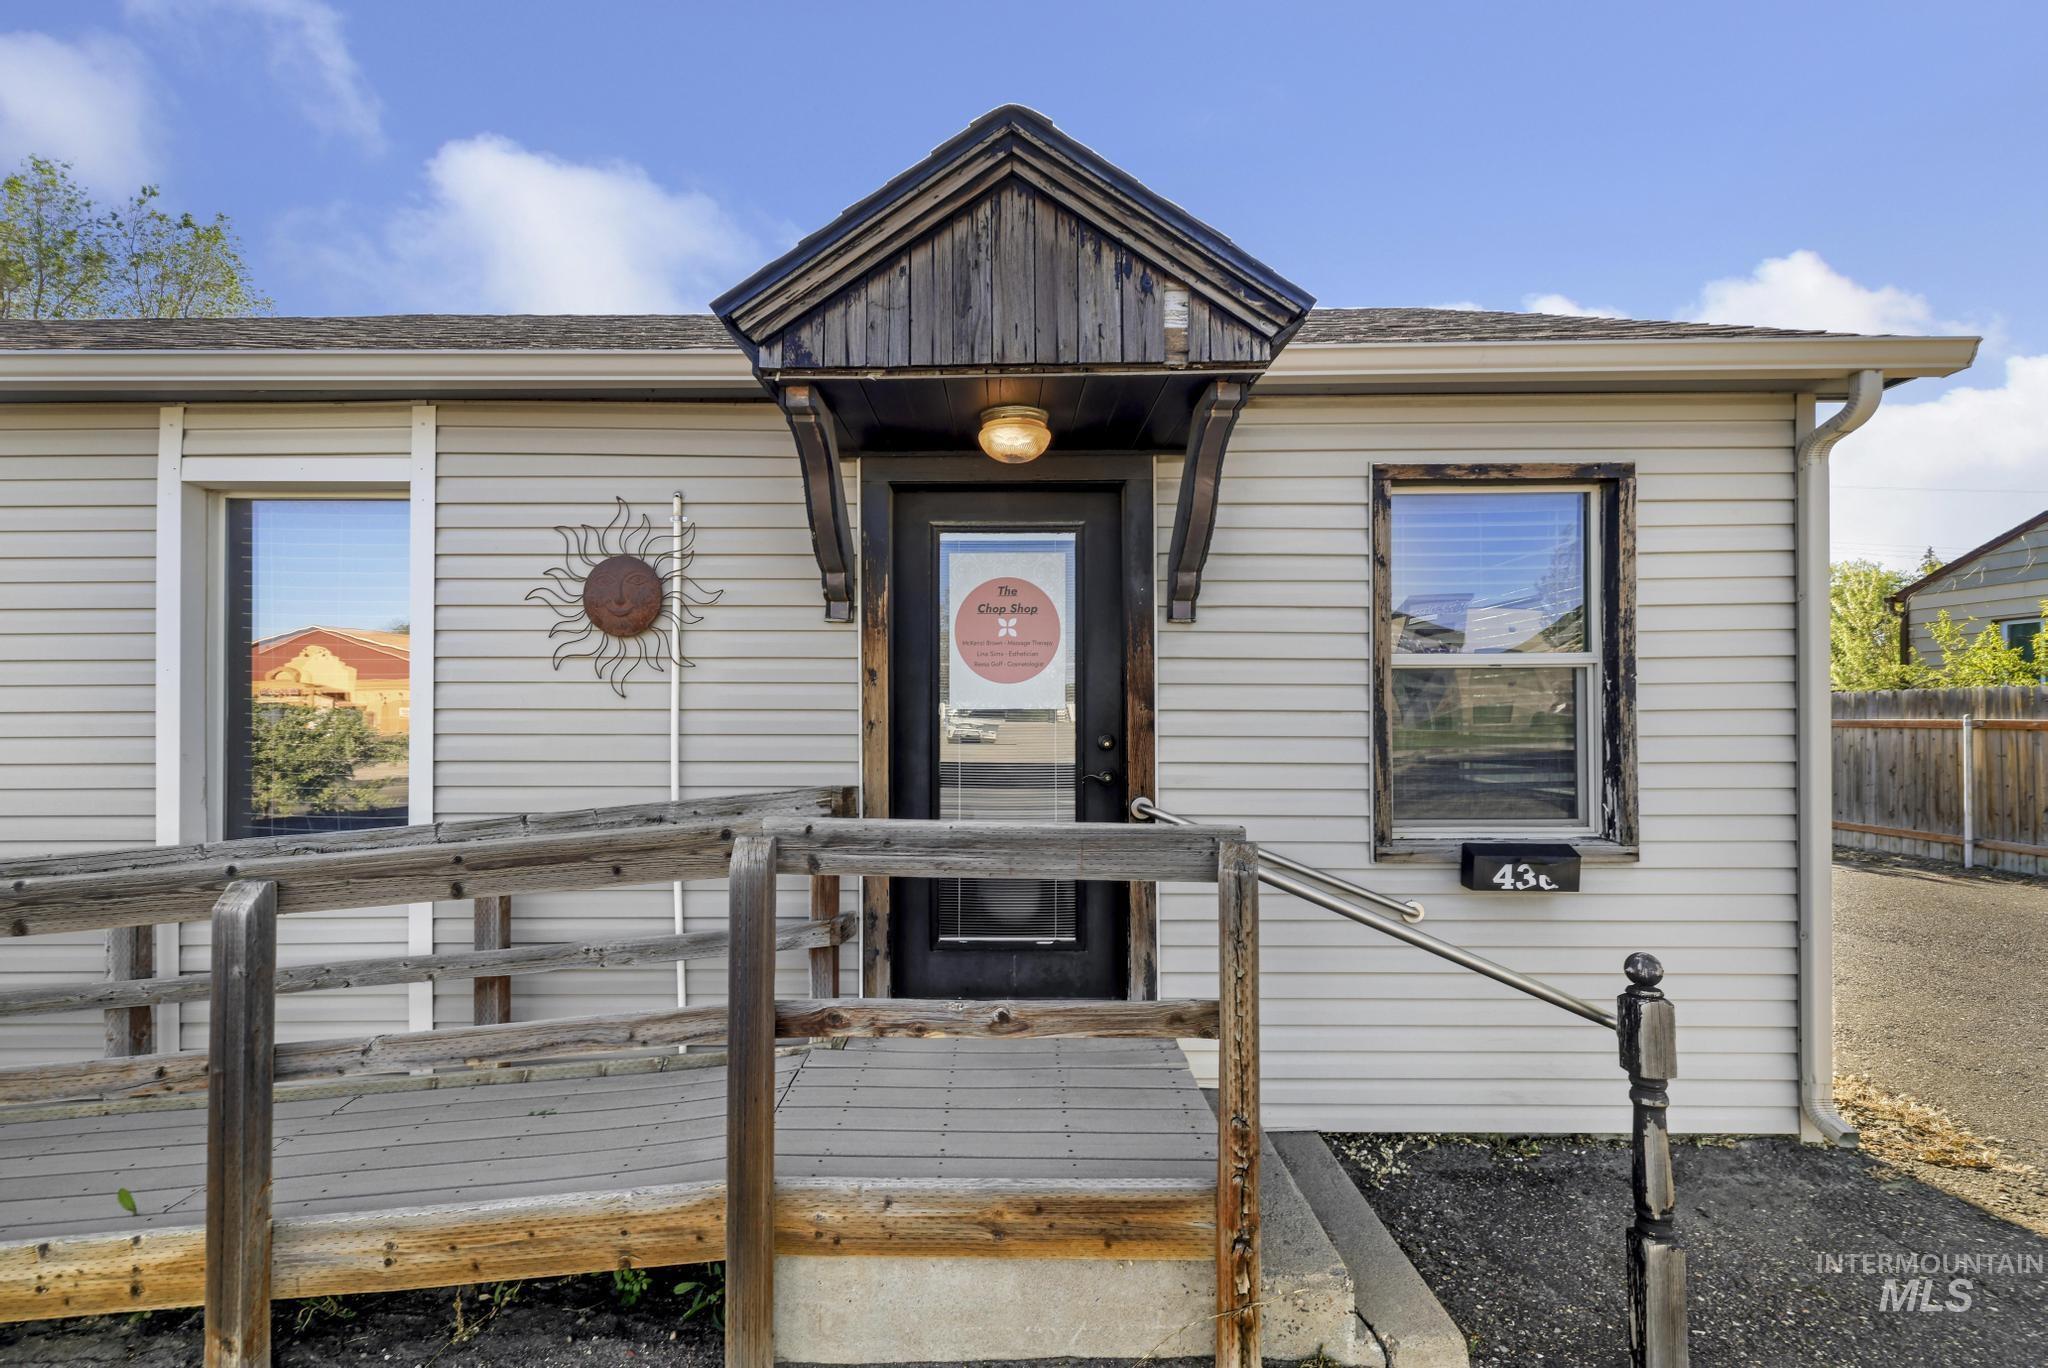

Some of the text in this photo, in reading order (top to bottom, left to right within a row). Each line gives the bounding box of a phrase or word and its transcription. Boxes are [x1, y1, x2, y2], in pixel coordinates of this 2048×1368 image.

[997, 585, 1018, 597] The
[977, 603, 1038, 616] Chop Shop
[1032, 639, 1054, 648] Therapy
